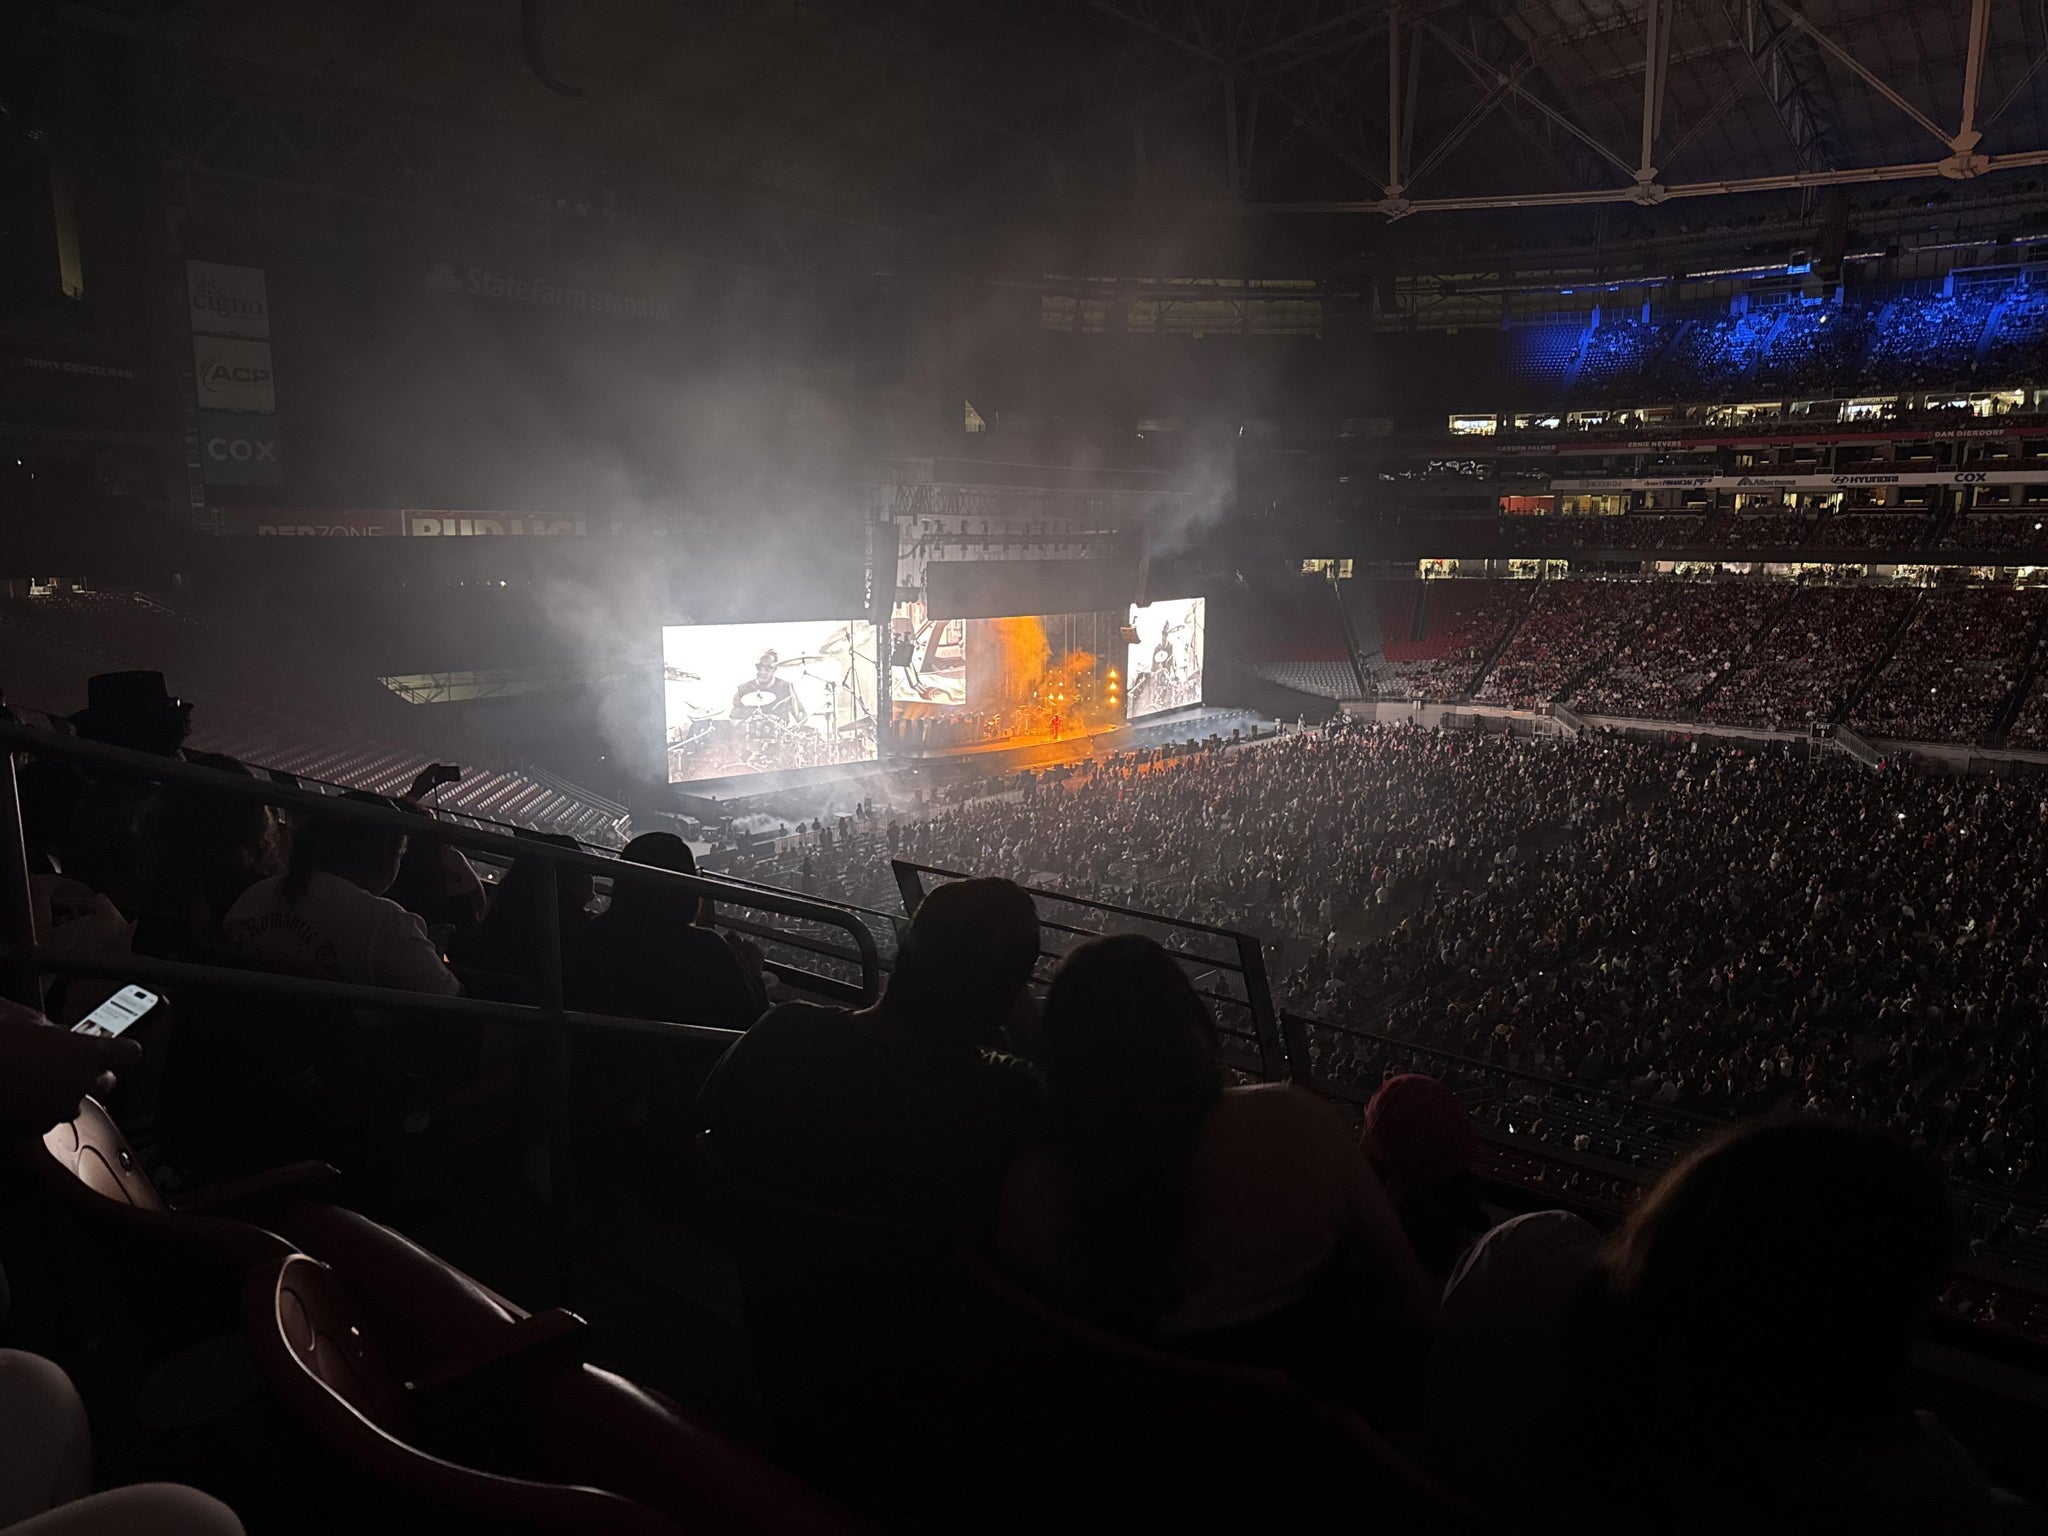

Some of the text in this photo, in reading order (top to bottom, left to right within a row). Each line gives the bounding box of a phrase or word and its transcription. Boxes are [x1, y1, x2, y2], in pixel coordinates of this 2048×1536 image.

[1934, 428, 2005, 439] DAN DIERDORF
[1527, 443, 1557, 452] PALMER
[1627, 440, 1682, 448] ERNIE NEVERS
[208, 438, 278, 463] COX
[1850, 475, 1899, 483] HYUNDAI
[1954, 472, 1987, 482] COX
